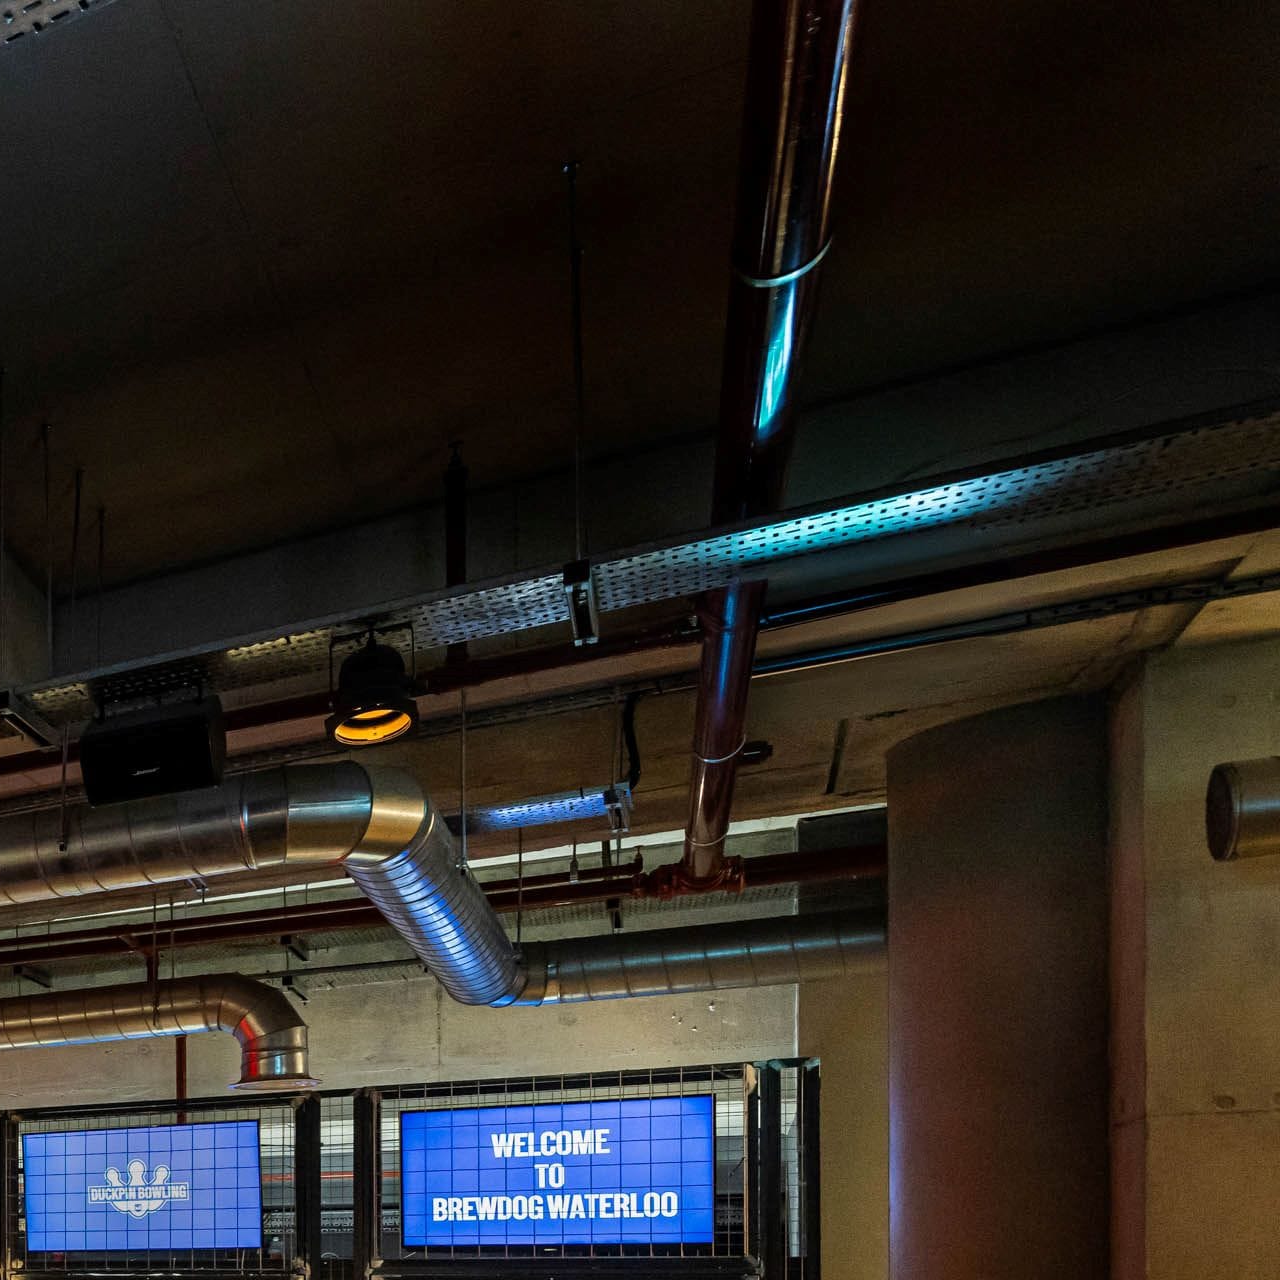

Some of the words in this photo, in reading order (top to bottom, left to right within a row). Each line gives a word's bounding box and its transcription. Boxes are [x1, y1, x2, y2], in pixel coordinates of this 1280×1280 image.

[491, 1128, 610, 1158] WELCOME
[534, 1163, 565, 1189] TO
[91, 1188, 136, 1200] DUCKPIN
[138, 1186, 186, 1199] BOWLING
[432, 1195, 543, 1221] BREWDOG
[547, 1191, 678, 1220] WATERLOO
